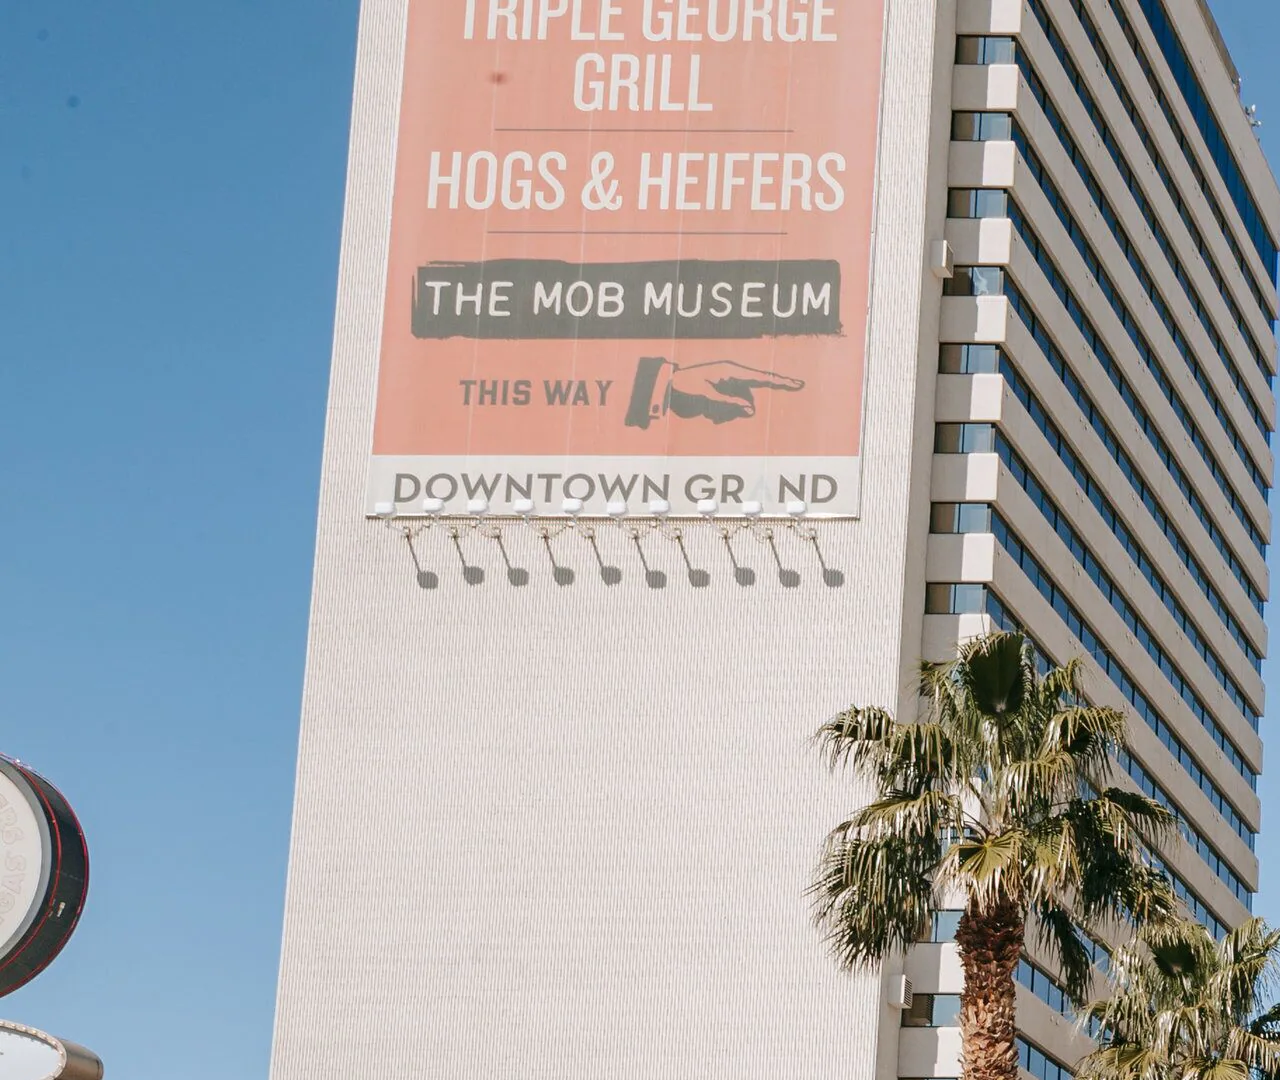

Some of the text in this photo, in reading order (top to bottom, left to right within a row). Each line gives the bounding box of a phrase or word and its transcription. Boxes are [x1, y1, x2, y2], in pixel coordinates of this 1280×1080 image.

[463, 0, 838, 42] TRIPLE GEORGE
[573, 53, 713, 113] GRILL
[427, 151, 846, 211] HOGS & HEIFERS
[424, 280, 832, 318] THE MOB MUSEUM
[459, 380, 613, 406] THIS WAY
[394, 473, 670, 504] DOWNTOWN
